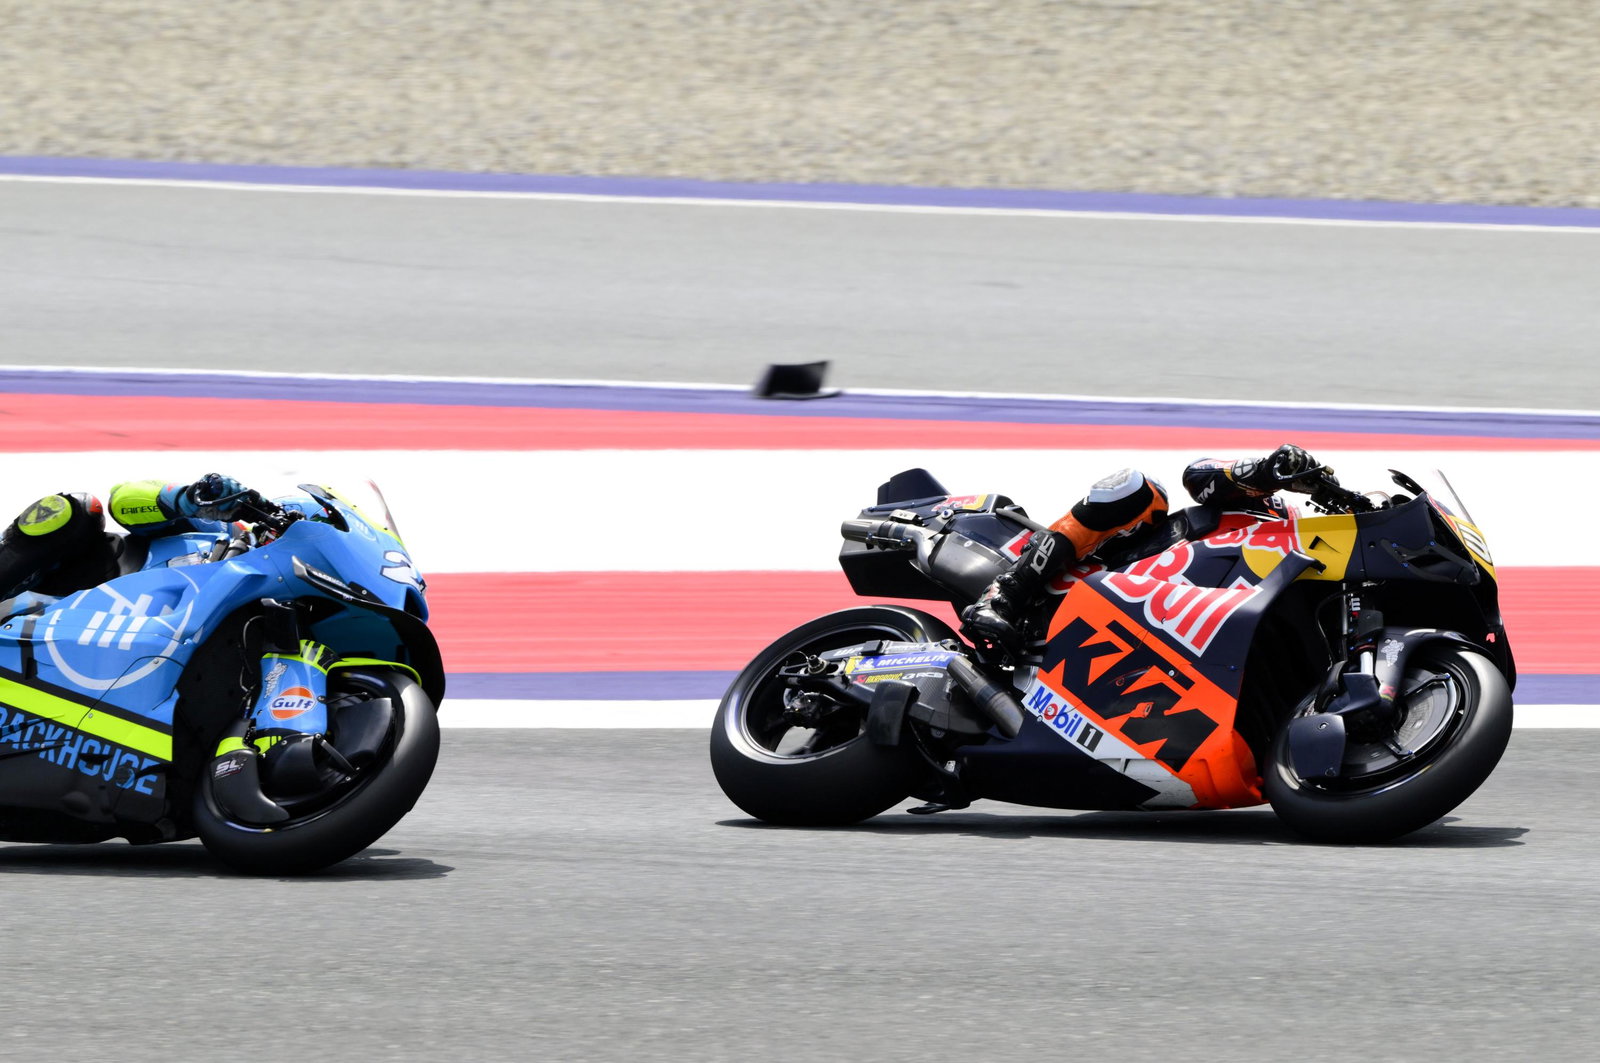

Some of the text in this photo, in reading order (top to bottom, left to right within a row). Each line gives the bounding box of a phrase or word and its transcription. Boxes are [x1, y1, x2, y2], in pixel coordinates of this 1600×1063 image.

[121, 505, 159, 515] DAINESE
[1102, 540, 1263, 656] Bull
[877, 654, 949, 667] MICHELIN
[271, 698, 314, 710] Gulf
[1039, 616, 1219, 773] KTM
[1028, 685, 1097, 747] Mobil 1
